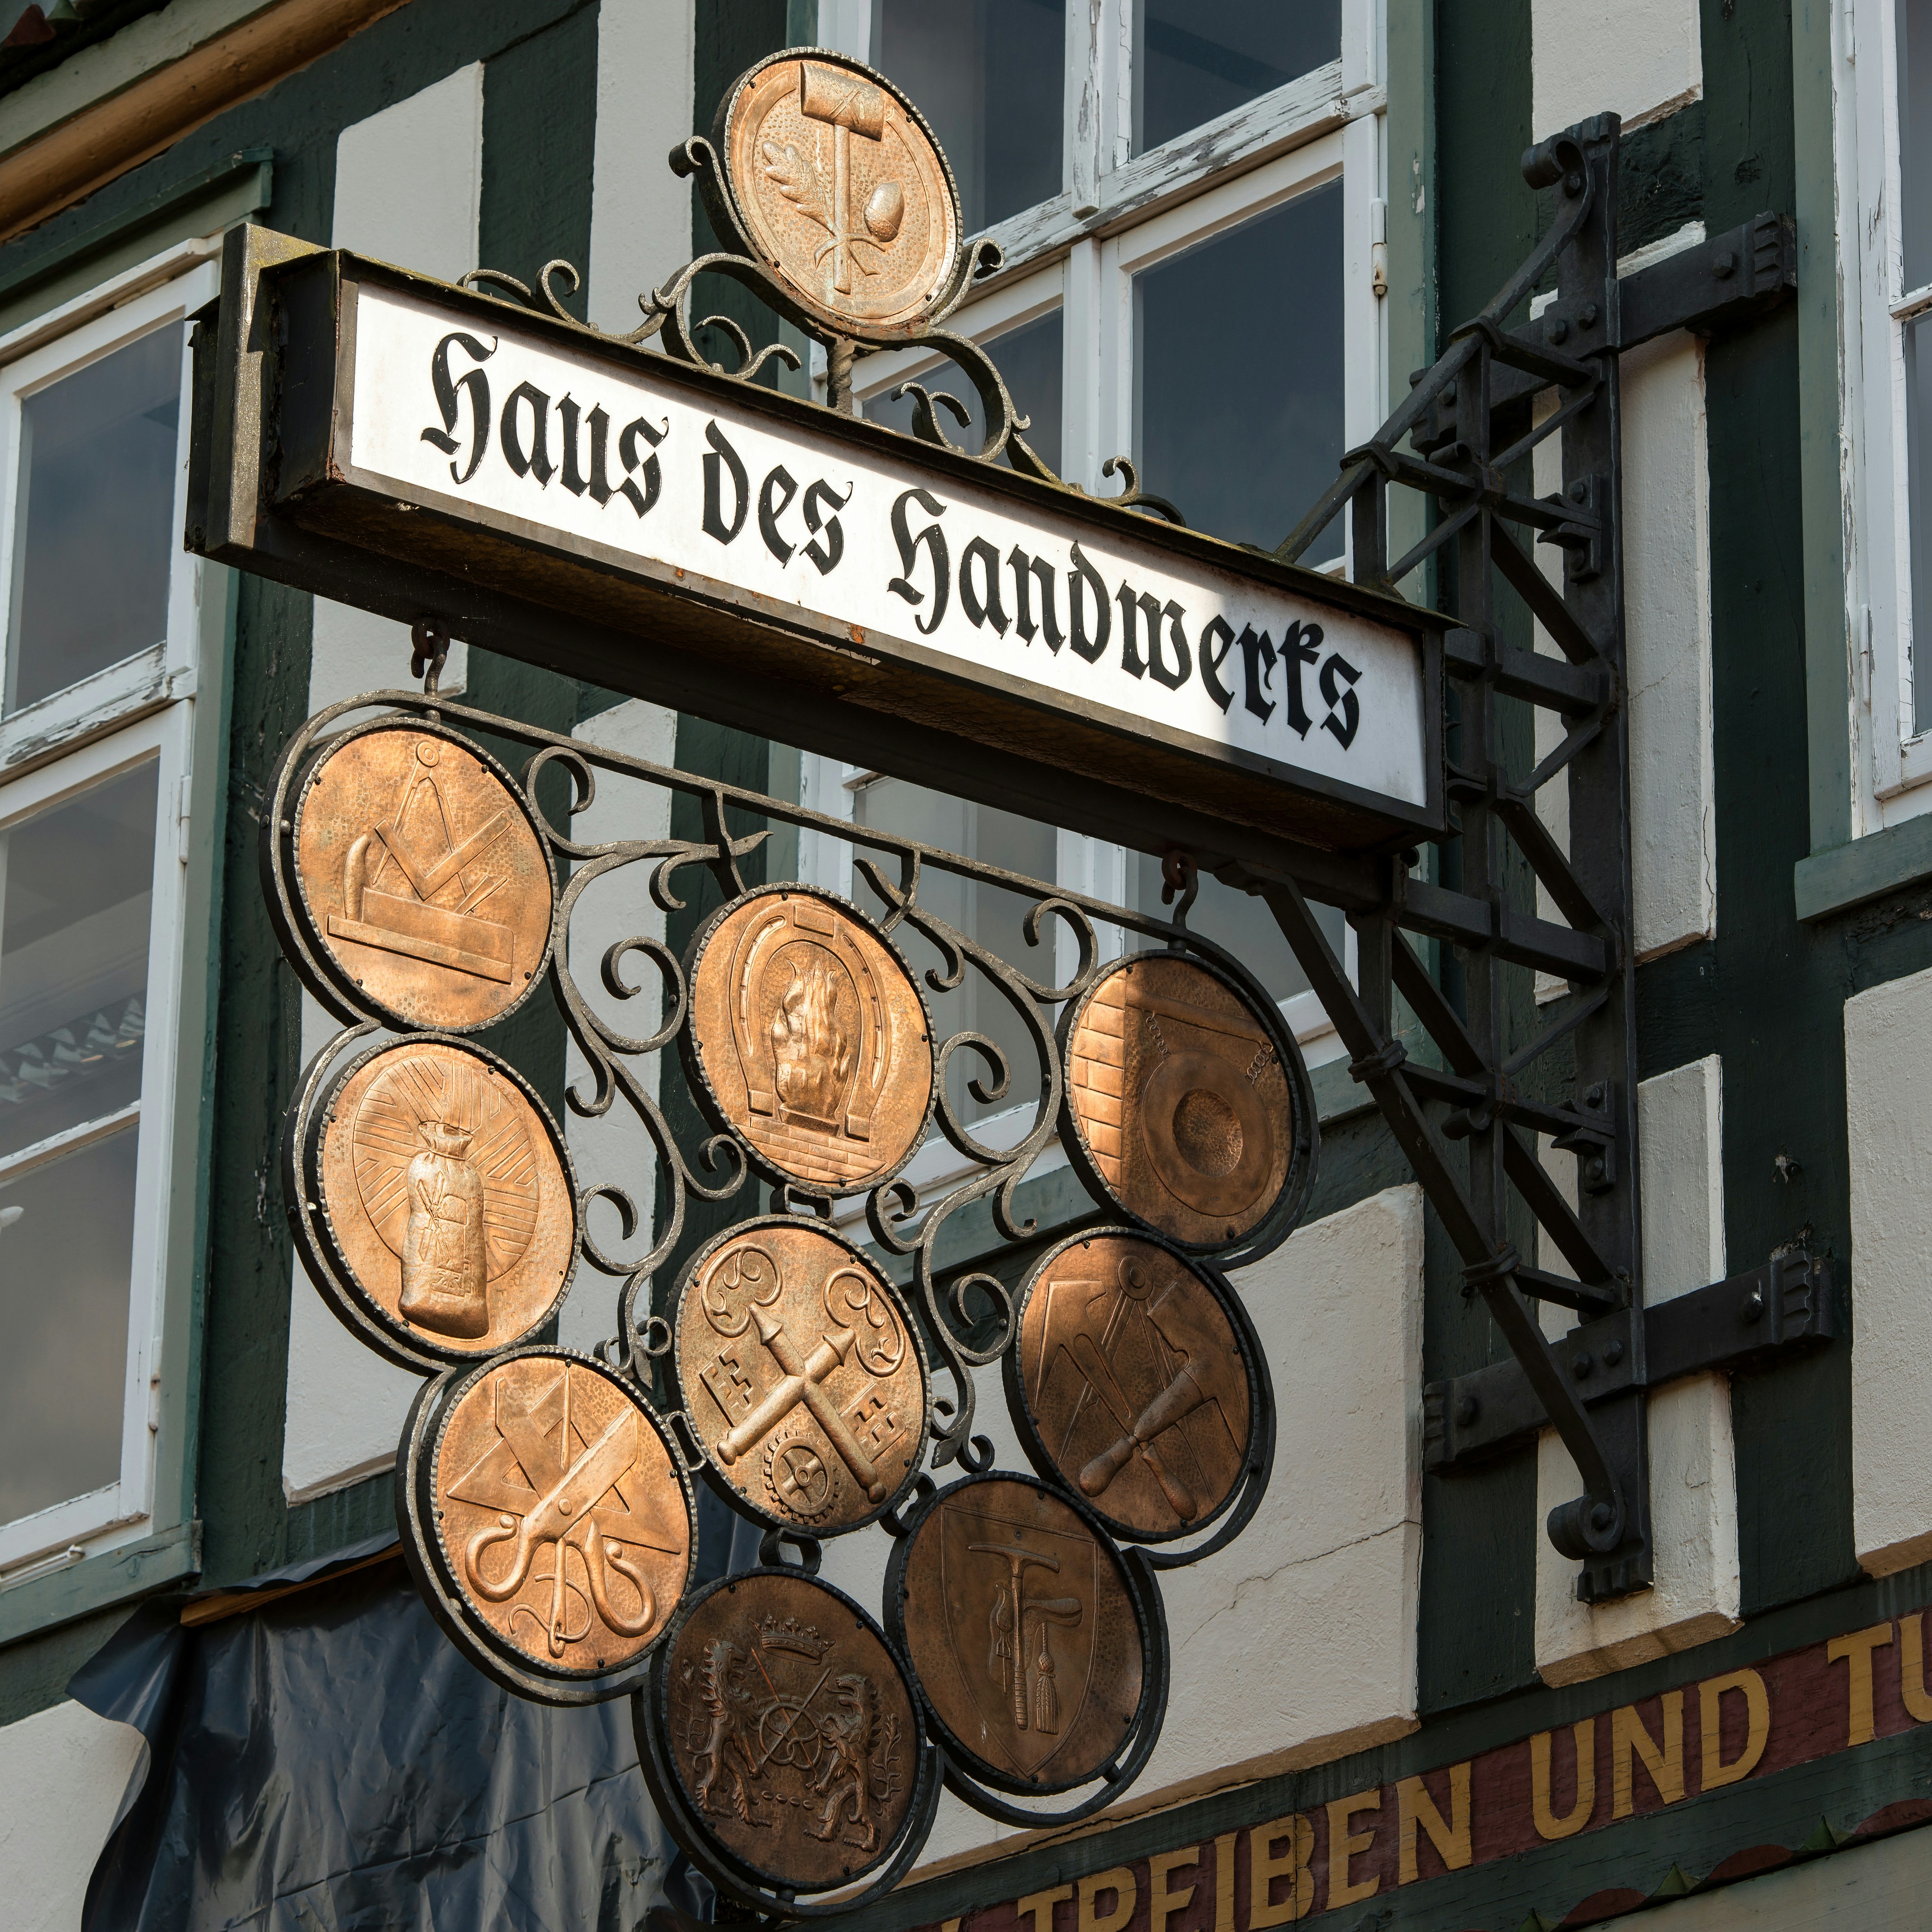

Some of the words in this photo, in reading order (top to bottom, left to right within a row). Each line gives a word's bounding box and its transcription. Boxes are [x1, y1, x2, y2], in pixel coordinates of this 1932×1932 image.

[420, 332, 669, 519] Haus
[701, 418, 853, 576] des
[887, 488, 1363, 751] Handwerks
[1530, 1668, 1770, 1840] UND
